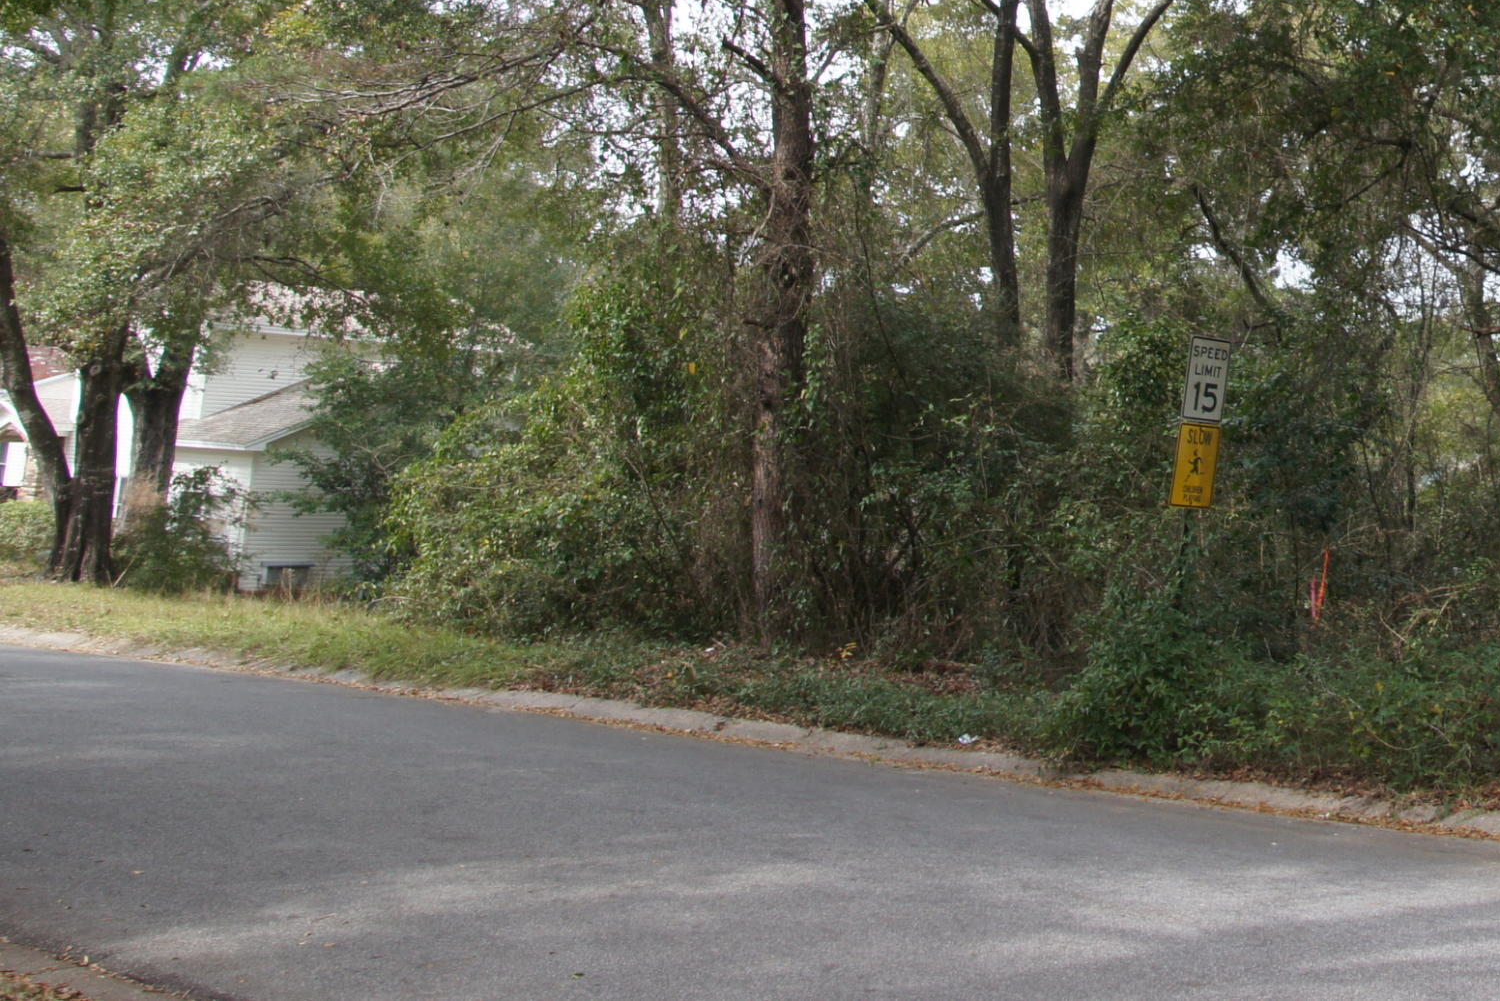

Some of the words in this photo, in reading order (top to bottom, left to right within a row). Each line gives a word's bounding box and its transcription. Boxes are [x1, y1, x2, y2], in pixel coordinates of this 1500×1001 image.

[1193, 345, 1228, 361] SPEED
[1194, 365, 1222, 379] LIMIT
[1193, 381, 1218, 413] 15
[1187, 428, 1213, 446] SLOW
